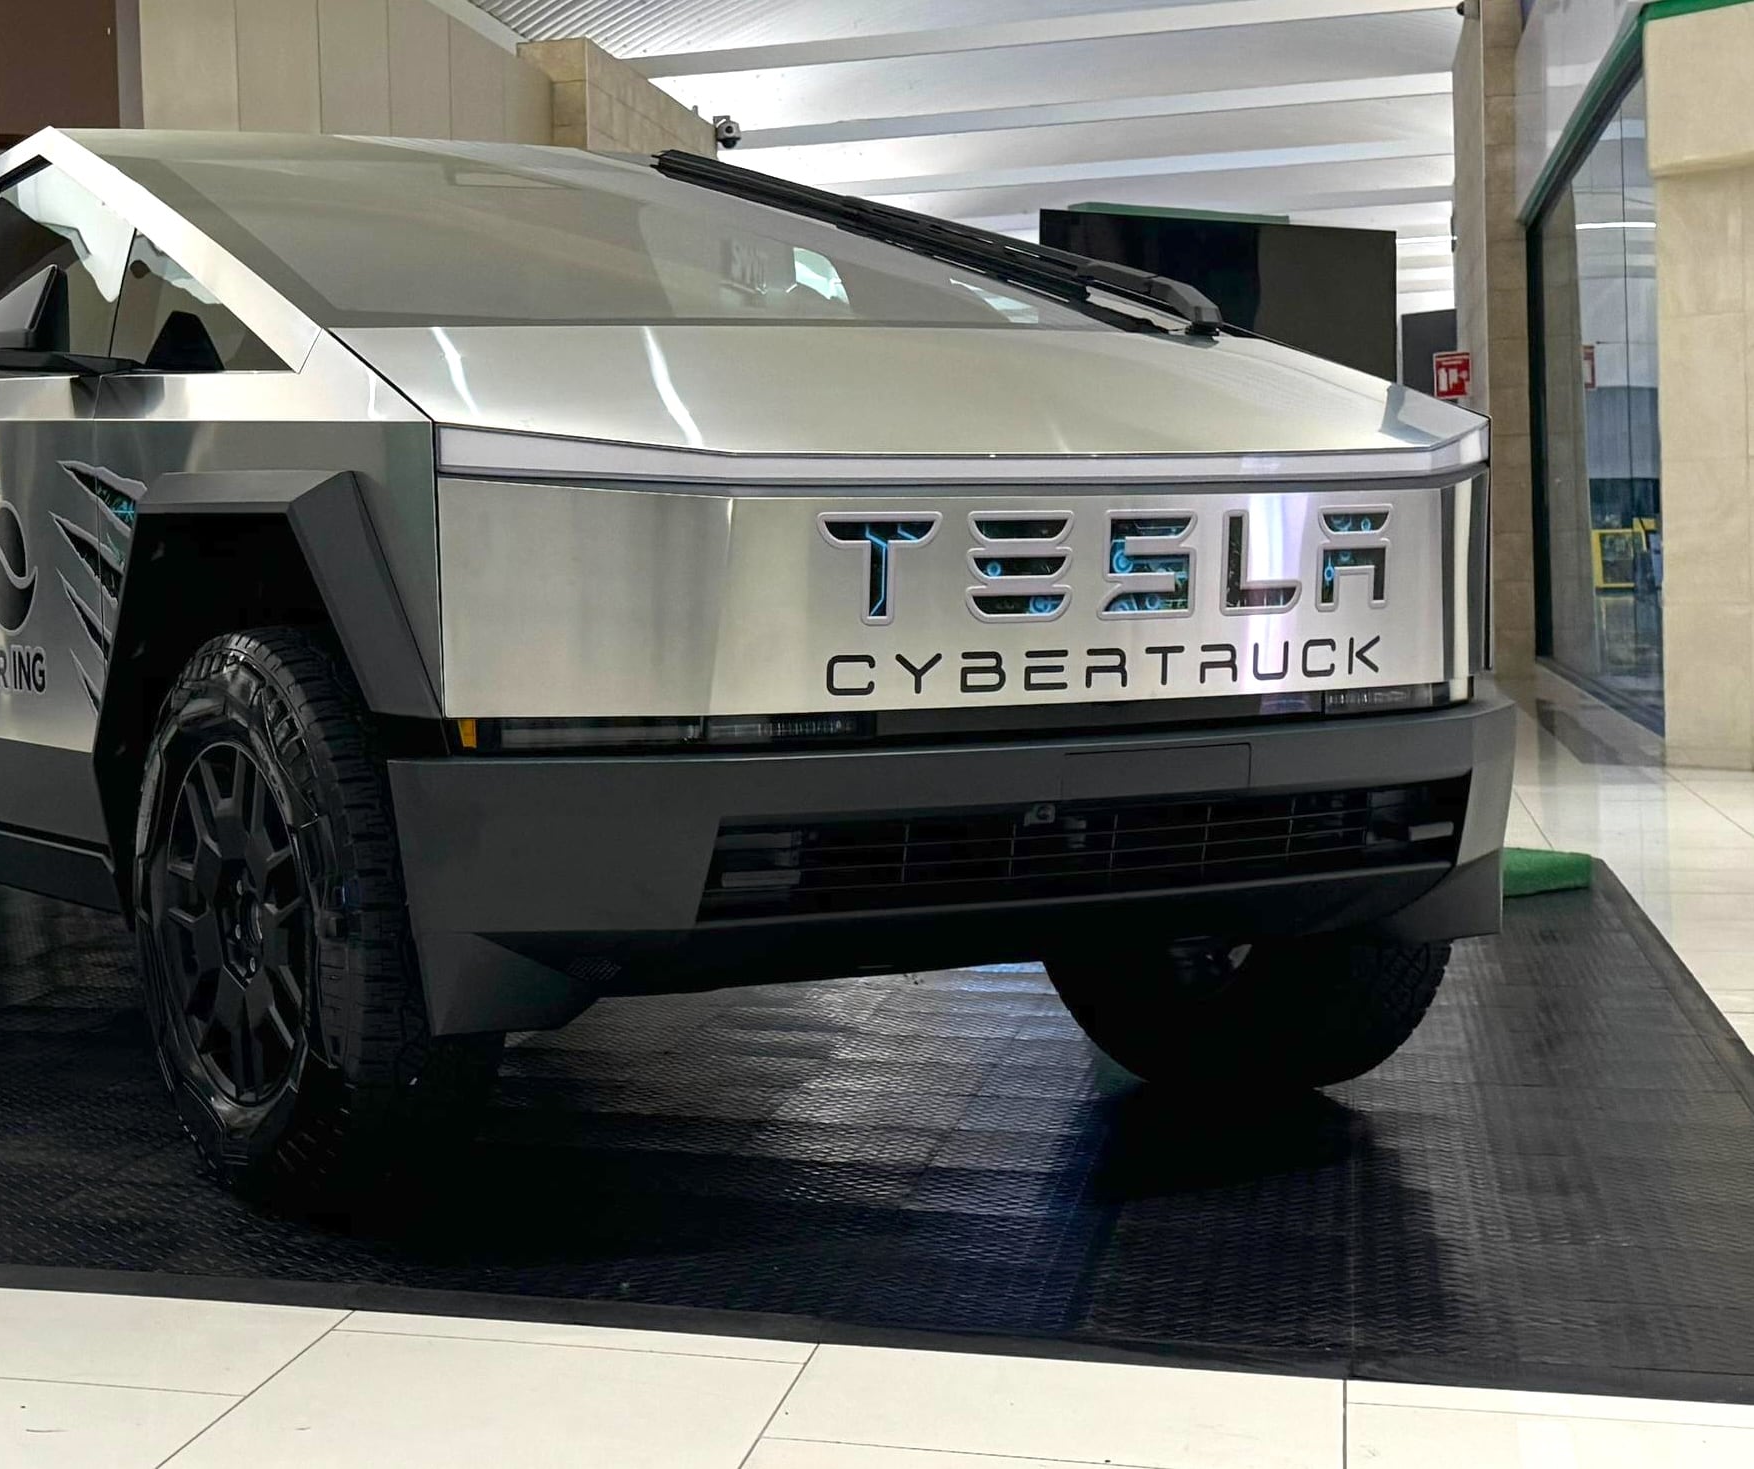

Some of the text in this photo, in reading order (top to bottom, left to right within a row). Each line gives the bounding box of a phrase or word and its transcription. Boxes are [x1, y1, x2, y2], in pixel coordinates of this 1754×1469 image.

[816, 503, 1394, 627] TESLA
[12, 649, 46, 693] ING
[826, 635, 1381, 697] CYBERTRUCK
